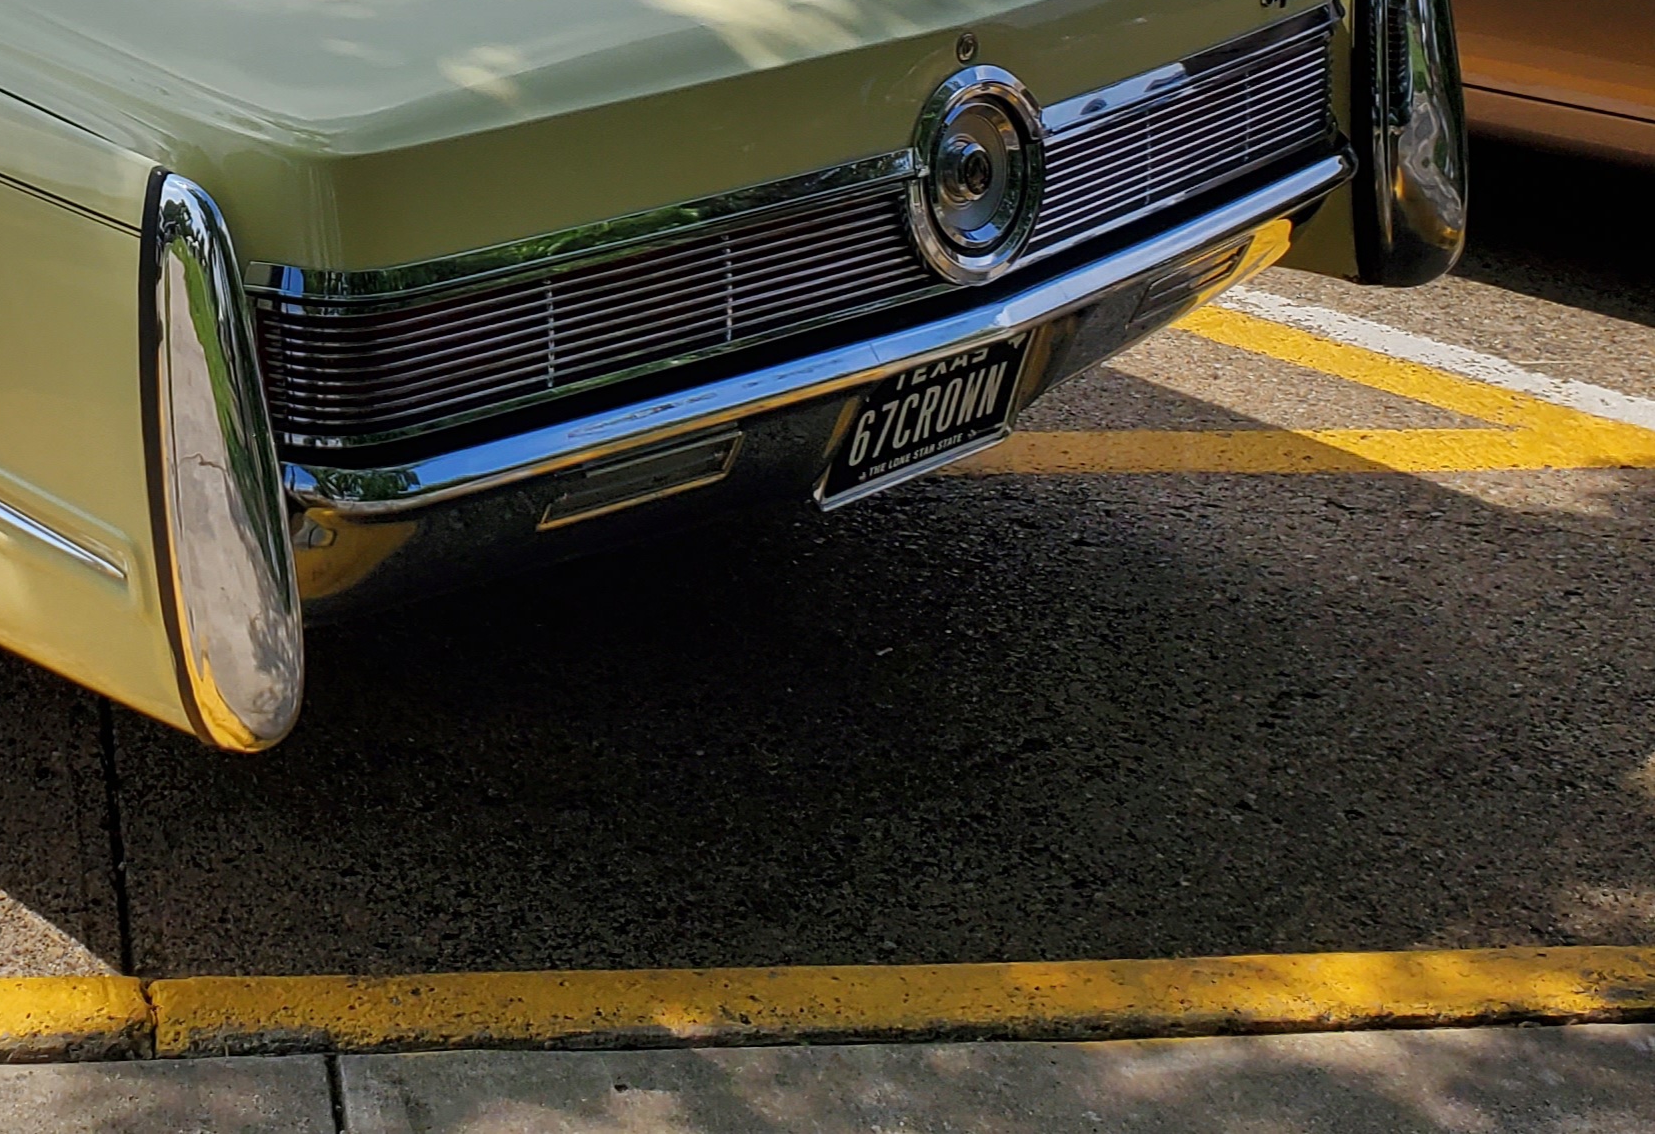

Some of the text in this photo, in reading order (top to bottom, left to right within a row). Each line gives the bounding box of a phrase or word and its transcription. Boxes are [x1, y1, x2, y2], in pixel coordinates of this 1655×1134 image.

[848, 360, 1008, 467] 67CROWN
[868, 432, 964, 477] THE LONE STAR STATE
